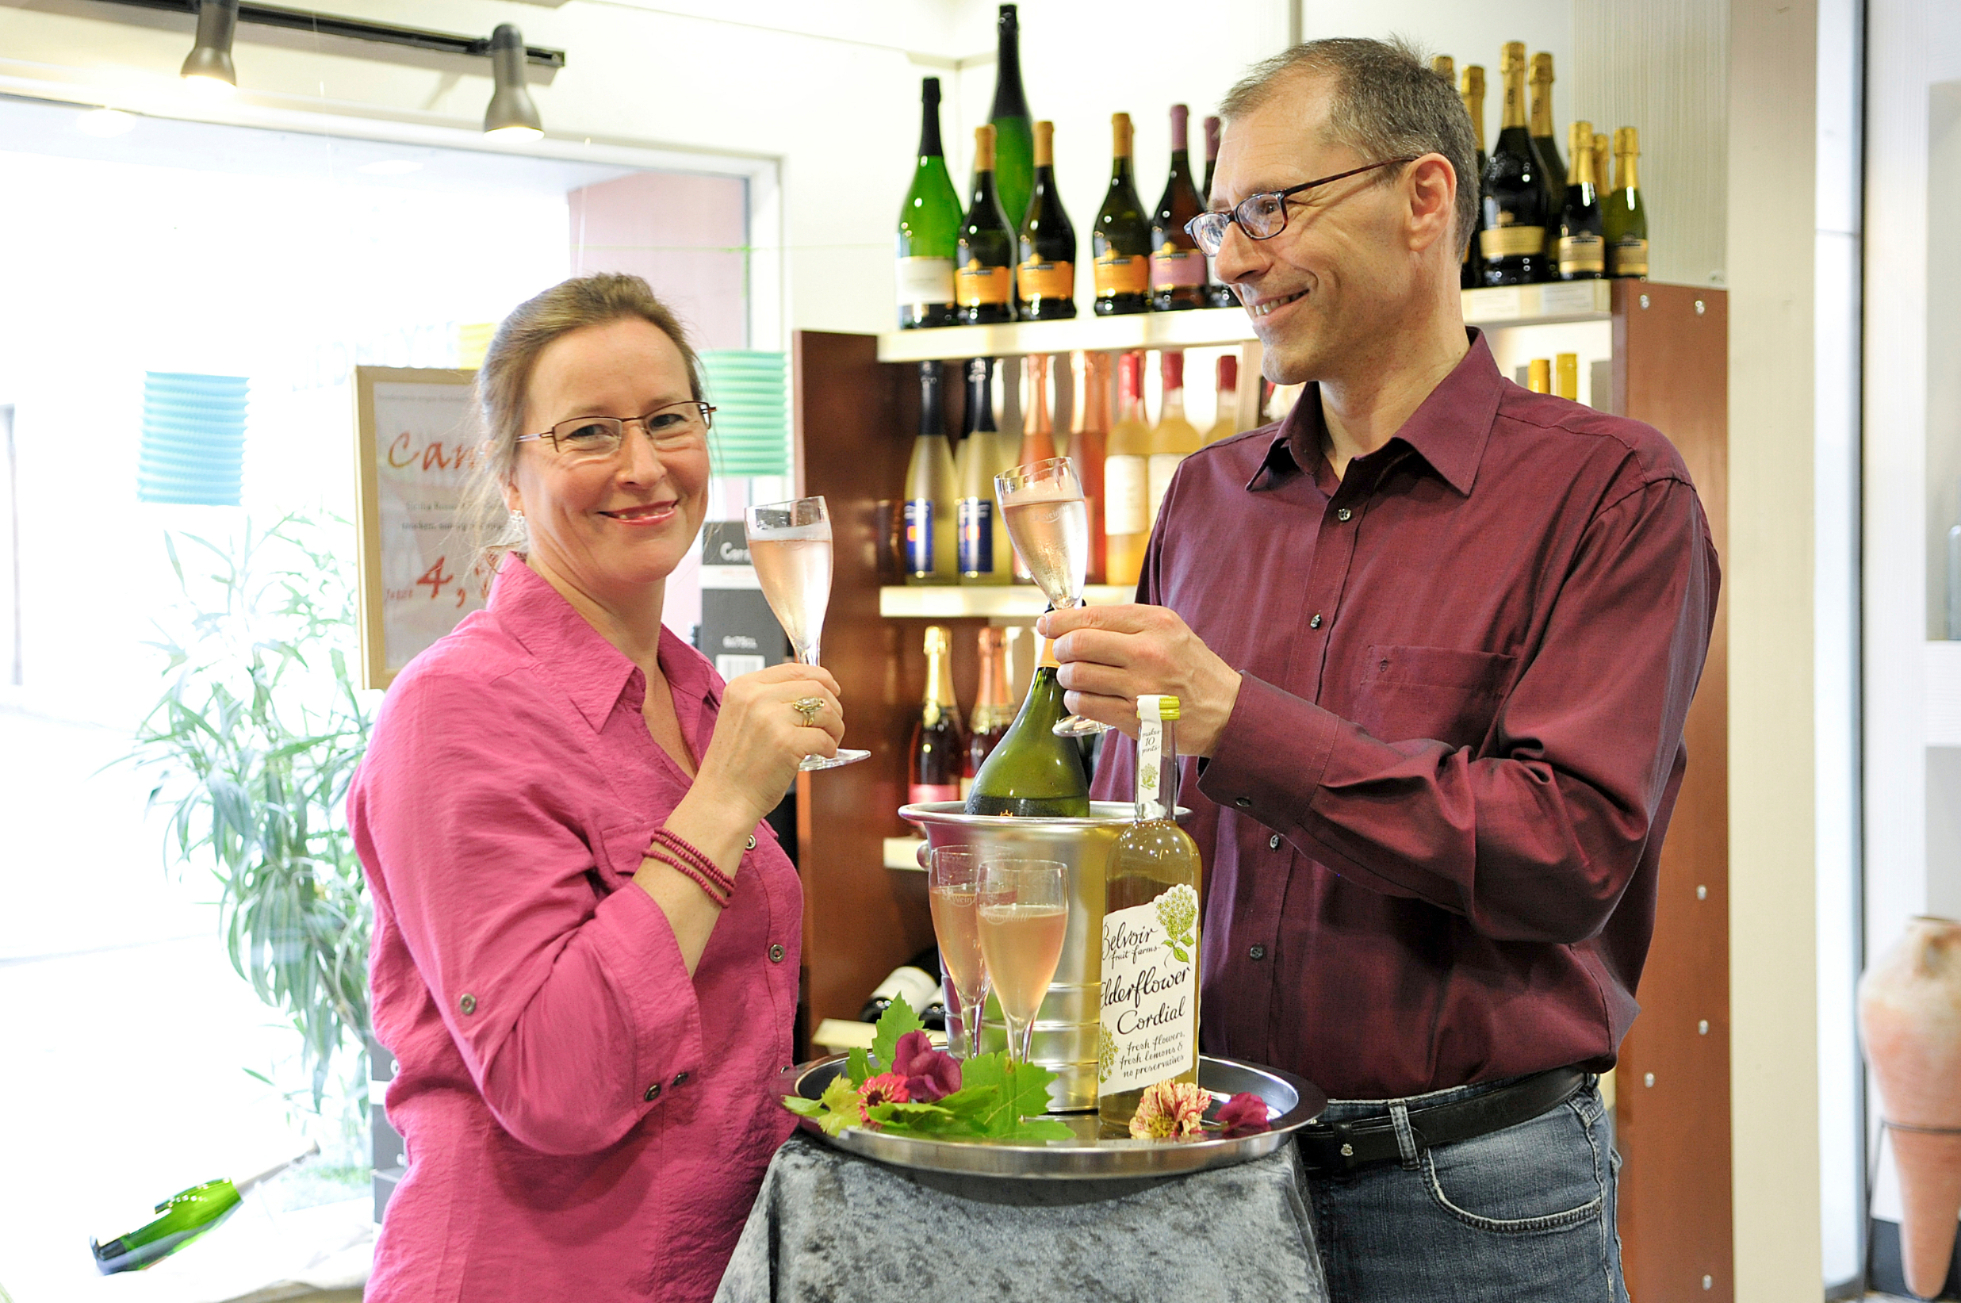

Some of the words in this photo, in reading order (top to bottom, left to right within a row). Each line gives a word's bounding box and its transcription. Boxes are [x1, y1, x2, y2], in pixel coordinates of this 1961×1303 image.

[1145, 736, 1155, 746] 10
[1103, 921, 1158, 960] Belvoir
[1109, 949, 1130, 969] fruit
[1132, 944, 1158, 964] farms
[1117, 995, 1186, 1035] Cordial
[1120, 1052, 1142, 1069] fresh
[1144, 1046, 1176, 1061] lemons
[1127, 1038, 1150, 1056] fresh
[1123, 1069, 1134, 1078] no
[1135, 1054, 1185, 1079] preservatives
